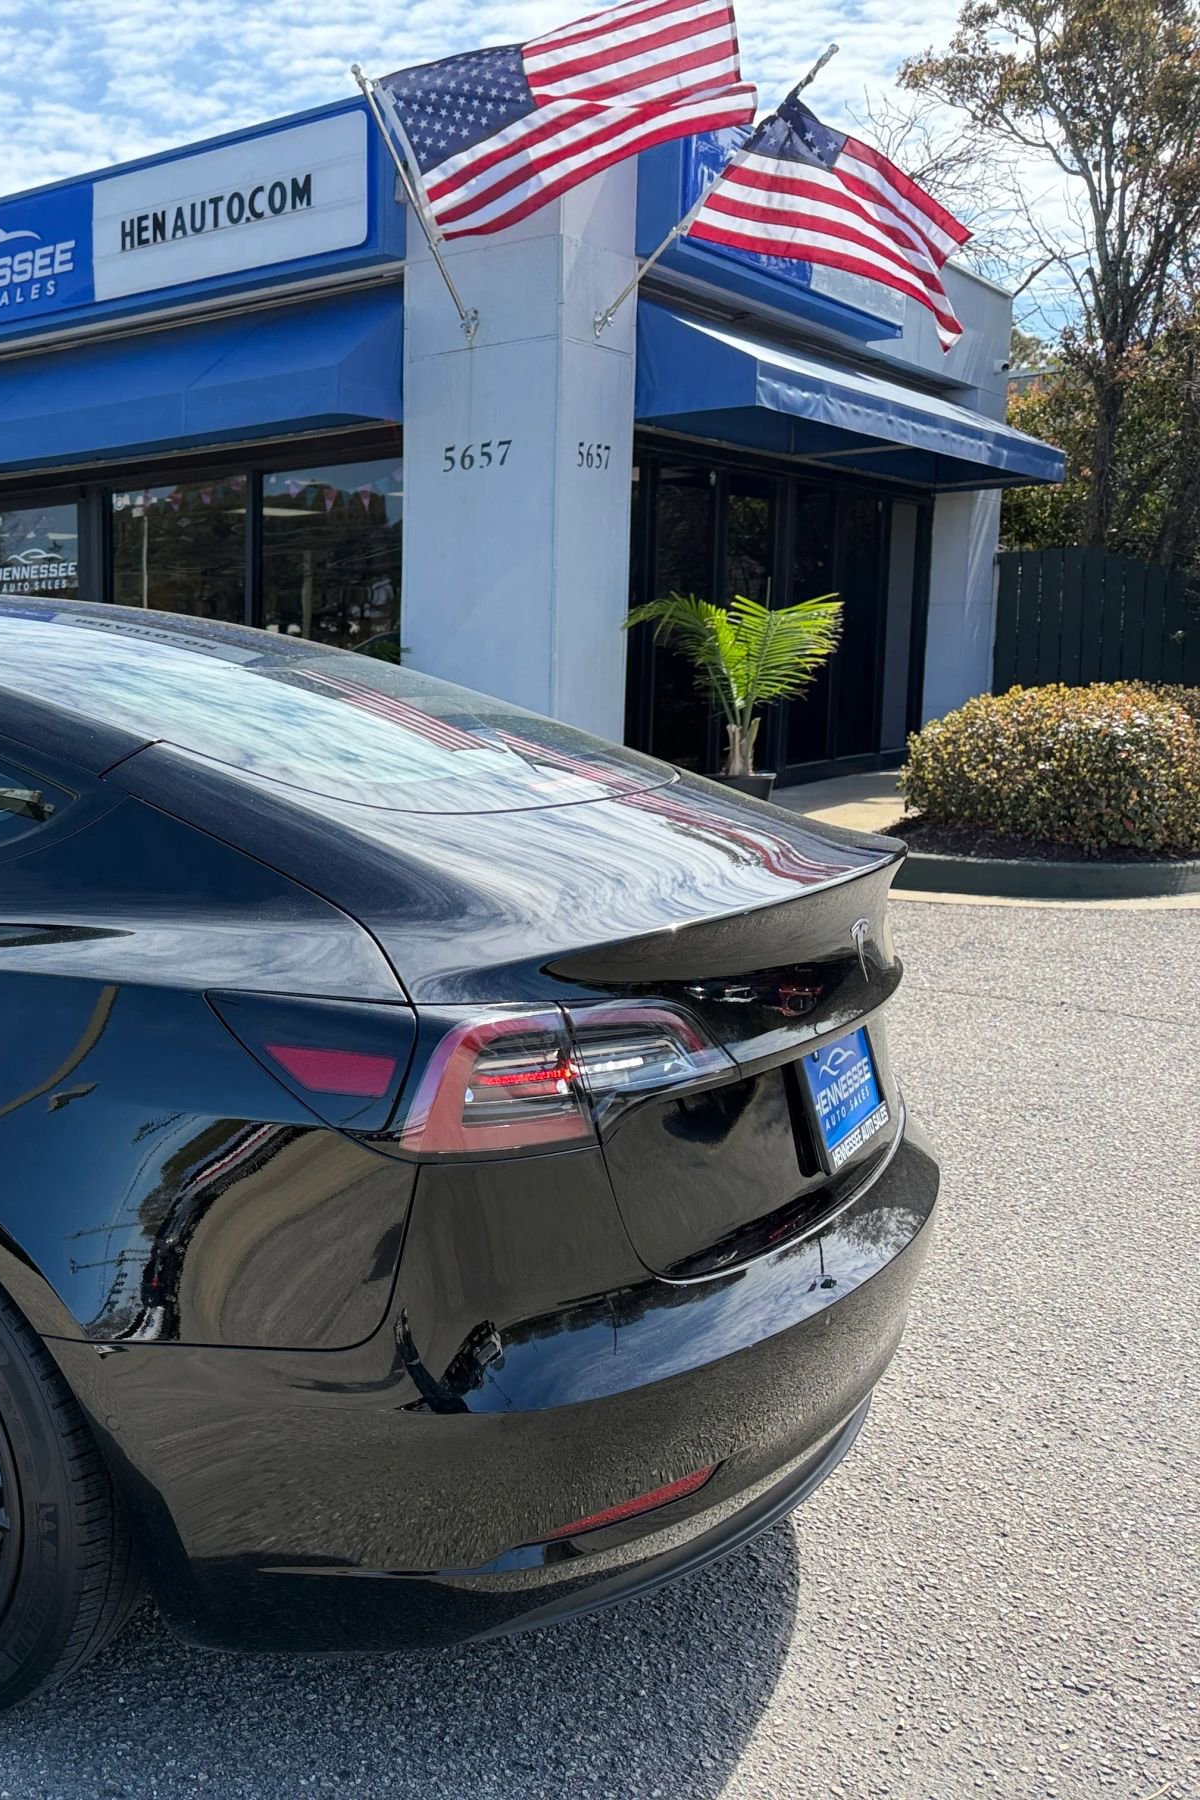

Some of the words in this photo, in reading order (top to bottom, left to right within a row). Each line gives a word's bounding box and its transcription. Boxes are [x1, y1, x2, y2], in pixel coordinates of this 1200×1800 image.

[120, 173, 312, 250] HENAUTO.COM
[442, 439, 513, 473] 5657
[576, 441, 611, 470] 5657
[1, 582, 30, 593] AUTO
[34, 579, 67, 591] SALES
[815, 1056, 871, 1118] HENNESSEE
[824, 1107, 847, 1132] AUTO
[850, 1086, 870, 1112] SALES
[832, 1130, 863, 1168] HENNESSEE
[861, 1116, 876, 1143] AUTO
[873, 1105, 889, 1131] SALES
